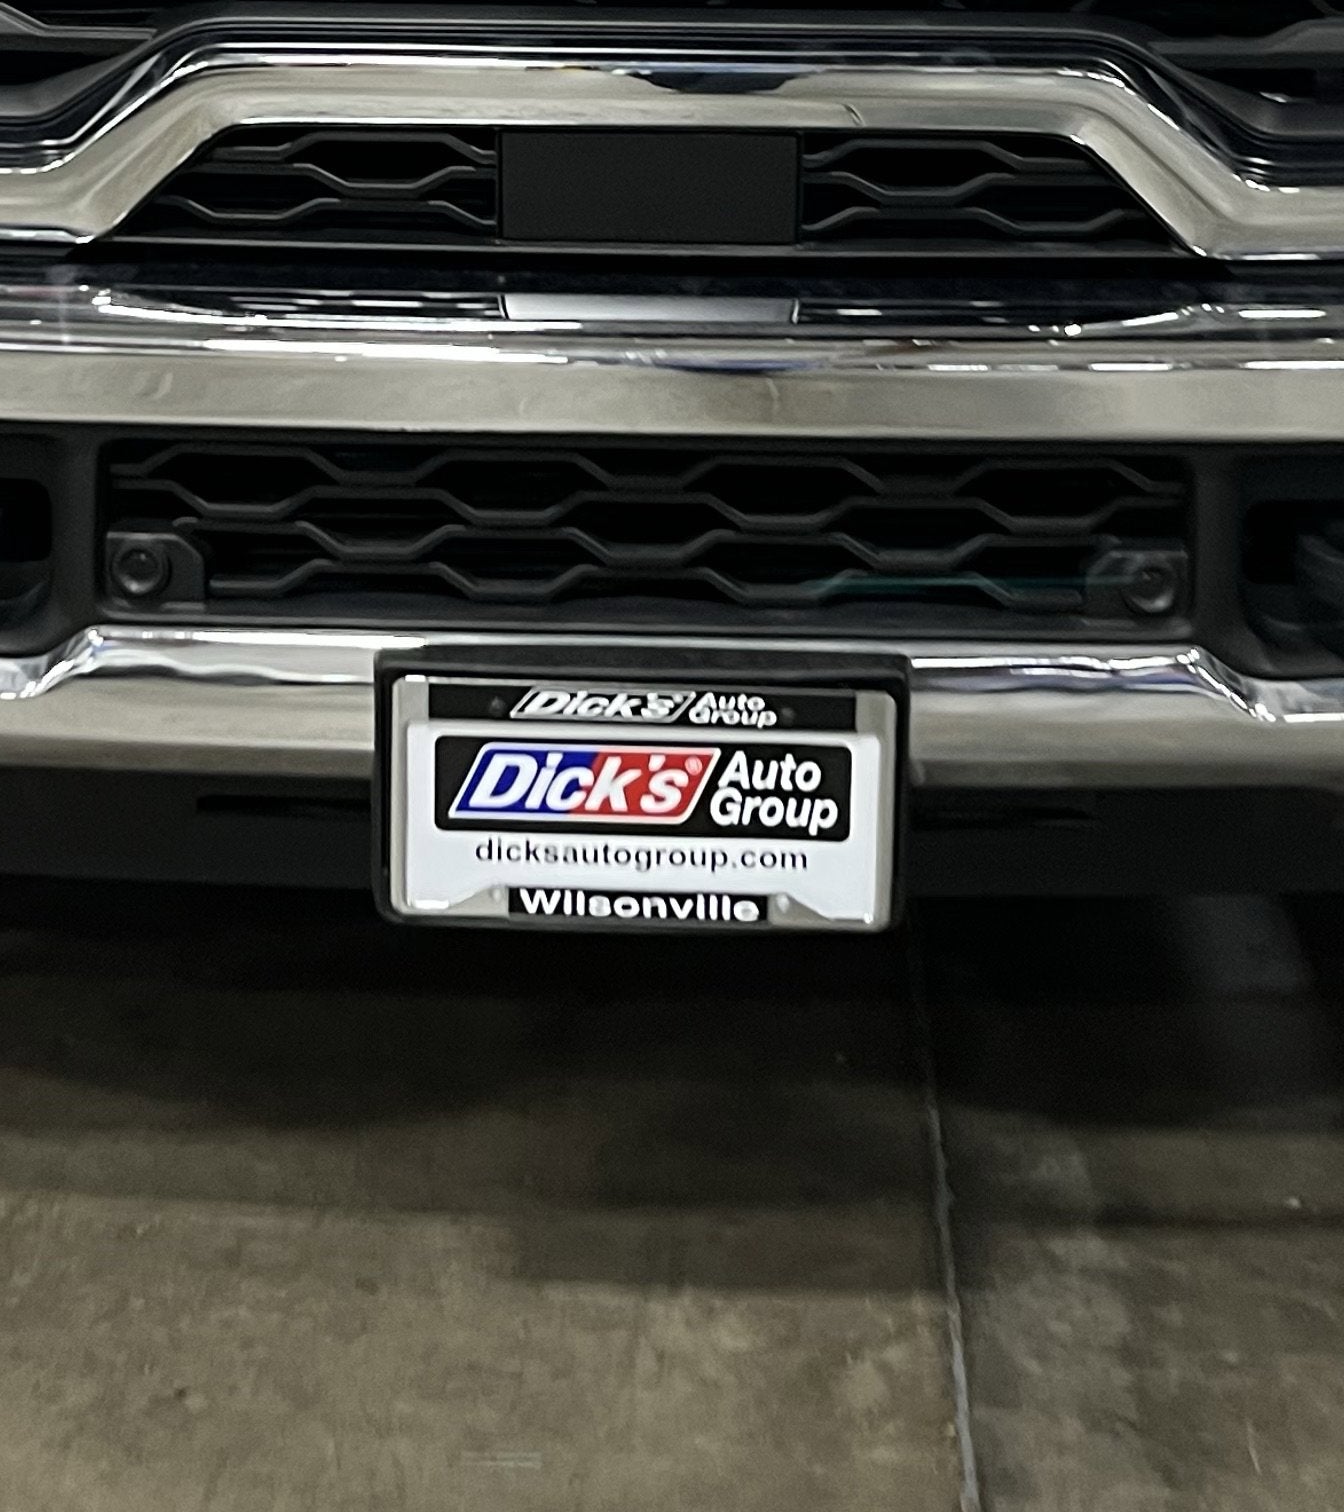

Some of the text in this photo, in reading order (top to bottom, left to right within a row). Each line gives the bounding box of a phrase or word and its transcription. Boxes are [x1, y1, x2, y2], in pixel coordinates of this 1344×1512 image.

[523, 690, 674, 719] Dick's
[688, 706, 778, 729] Group
[696, 692, 765, 711] Auto
[468, 751, 690, 814] Dick's
[717, 749, 823, 792] Auto
[709, 791, 839, 837] Group
[474, 837, 808, 873] dicksautogroup.com
[518, 888, 760, 922] Wilsonville
